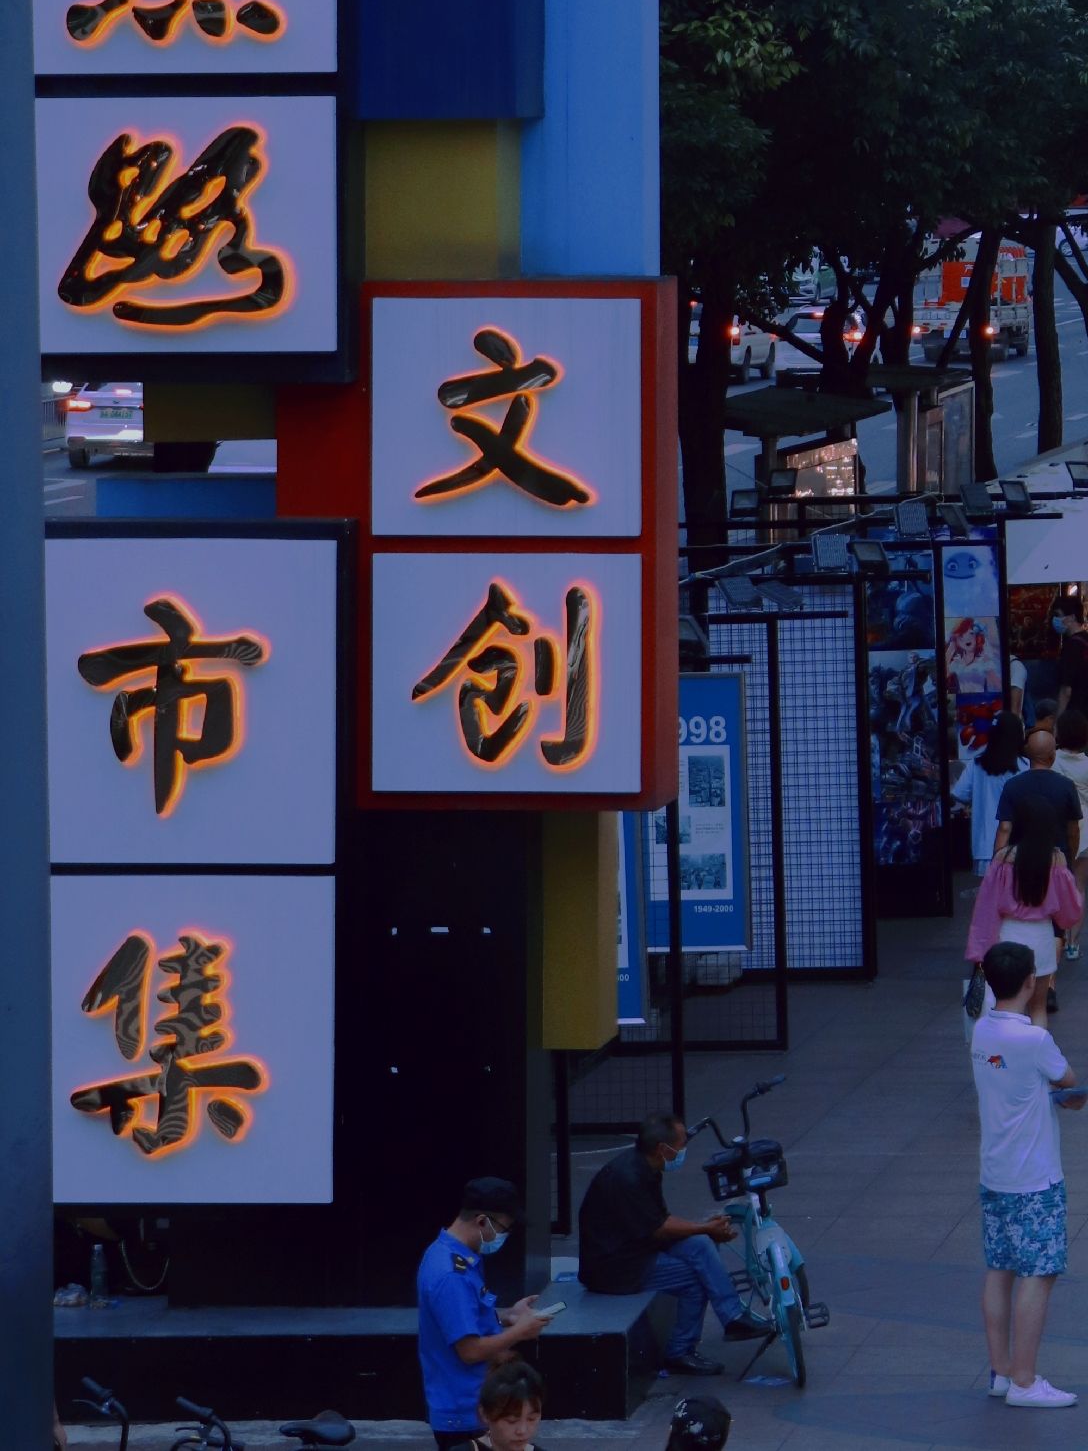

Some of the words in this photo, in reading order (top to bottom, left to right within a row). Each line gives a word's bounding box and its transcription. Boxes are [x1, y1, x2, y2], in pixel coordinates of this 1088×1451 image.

[411, 328, 593, 767] 文创
[70, 597, 265, 1156] 市集
[694, 904, 734, 915] 1949-2000
